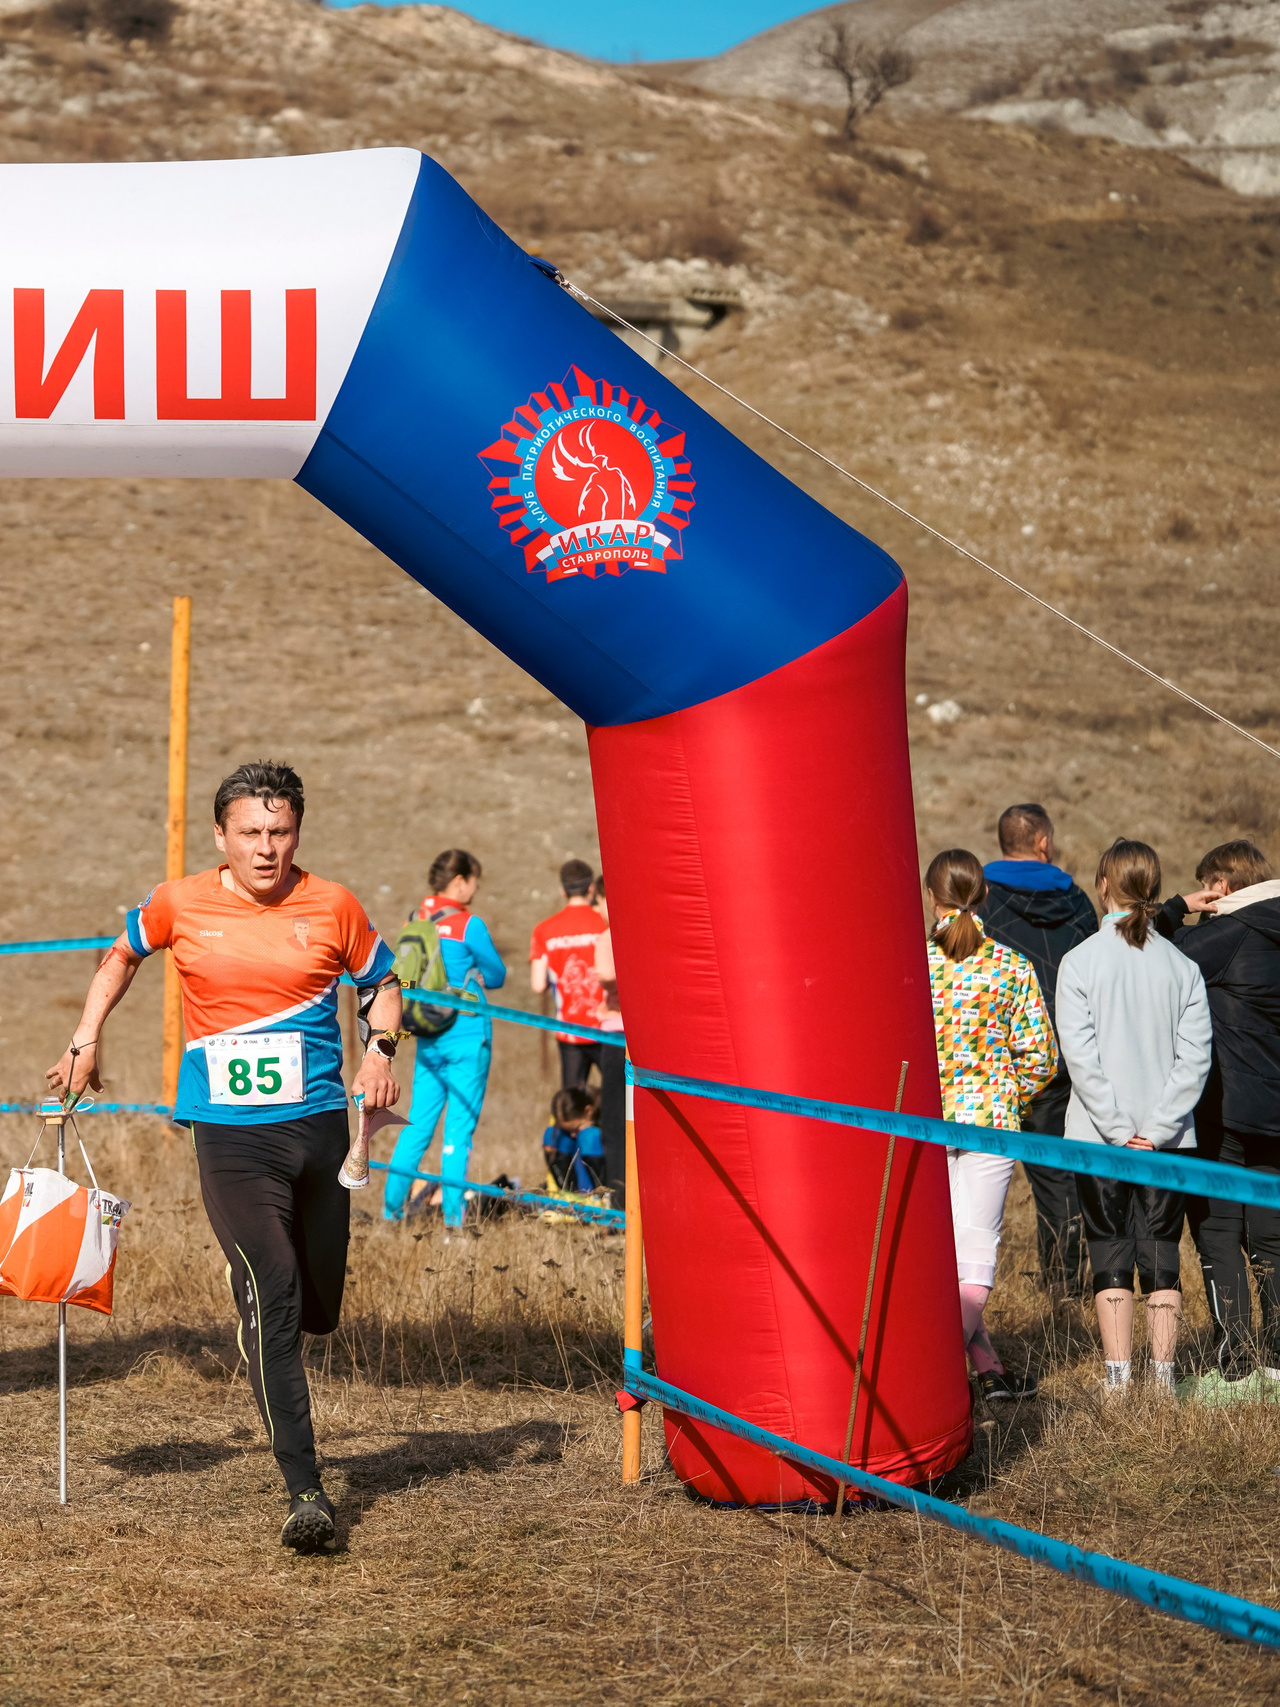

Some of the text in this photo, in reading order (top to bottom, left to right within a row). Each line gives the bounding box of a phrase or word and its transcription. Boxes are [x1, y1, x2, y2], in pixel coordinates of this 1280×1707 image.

[522, 407, 665, 524] КЛУБ ПАТРИОТИЧЕСКОГО ВОСПИТАНИЯ
[558, 523, 651, 555] ИКАР
[561, 549, 649, 569] СТАВРОПОЛЬ
[199, 929, 224, 937] Skog
[228, 1056, 282, 1096] 85
